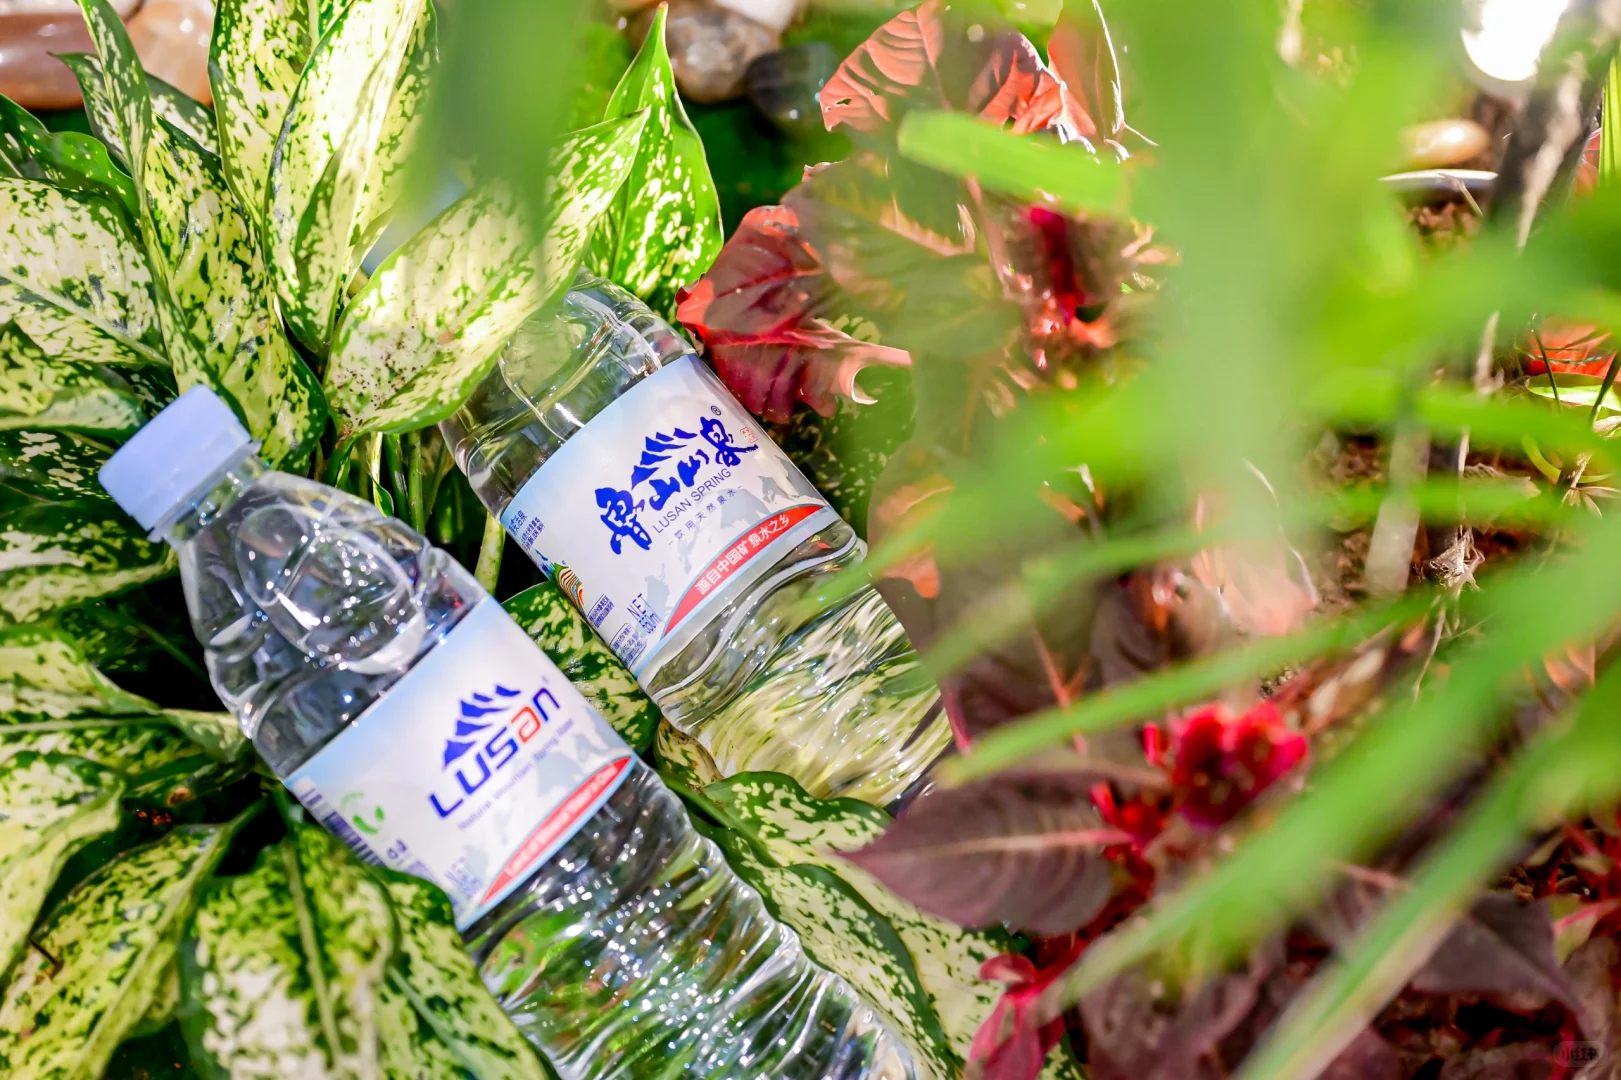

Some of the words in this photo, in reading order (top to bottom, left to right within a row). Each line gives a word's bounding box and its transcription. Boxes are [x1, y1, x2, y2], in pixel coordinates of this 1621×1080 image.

[652, 498, 693, 534] LUSAN
[690, 468, 732, 502] SPRING
[695, 515, 790, 596] 源自中国矿泉水之乡
[626, 593, 646, 622] NET
[638, 608, 663, 635] 550ml
